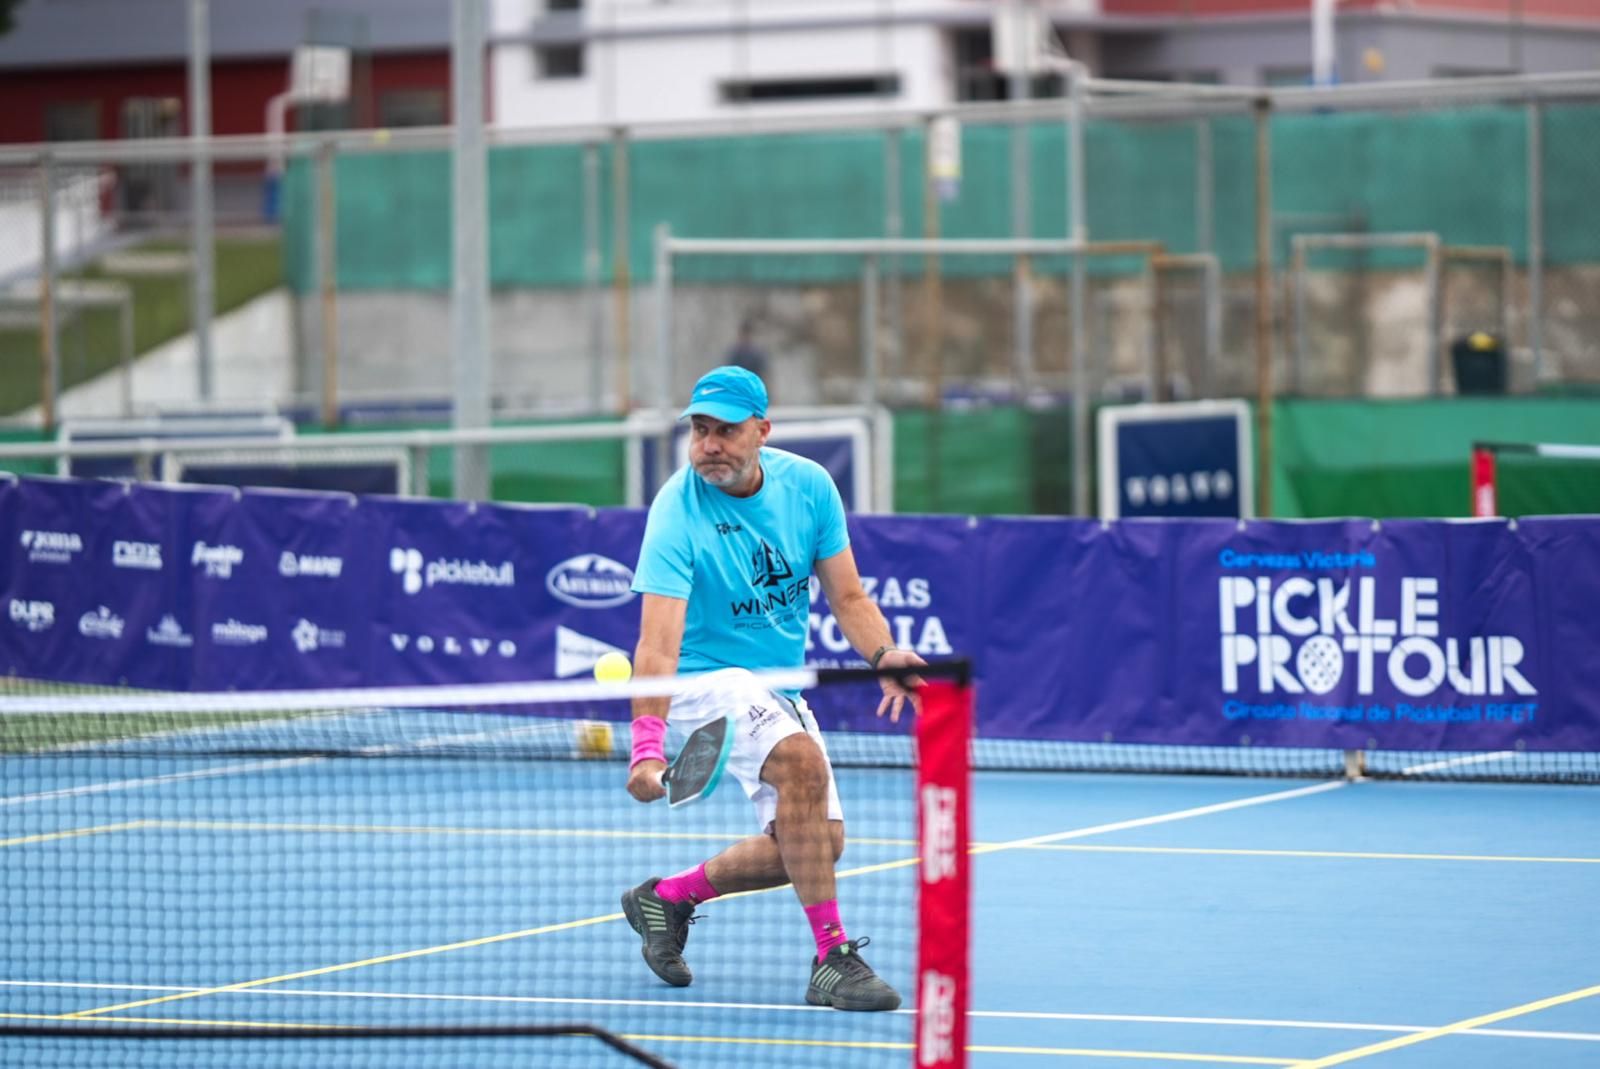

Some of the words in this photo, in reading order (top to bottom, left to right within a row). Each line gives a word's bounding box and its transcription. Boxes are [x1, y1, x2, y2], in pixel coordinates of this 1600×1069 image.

[426, 558, 515, 587] picklebull
[731, 575, 810, 616] WINNER
[391, 633, 517, 658] VOLVO
